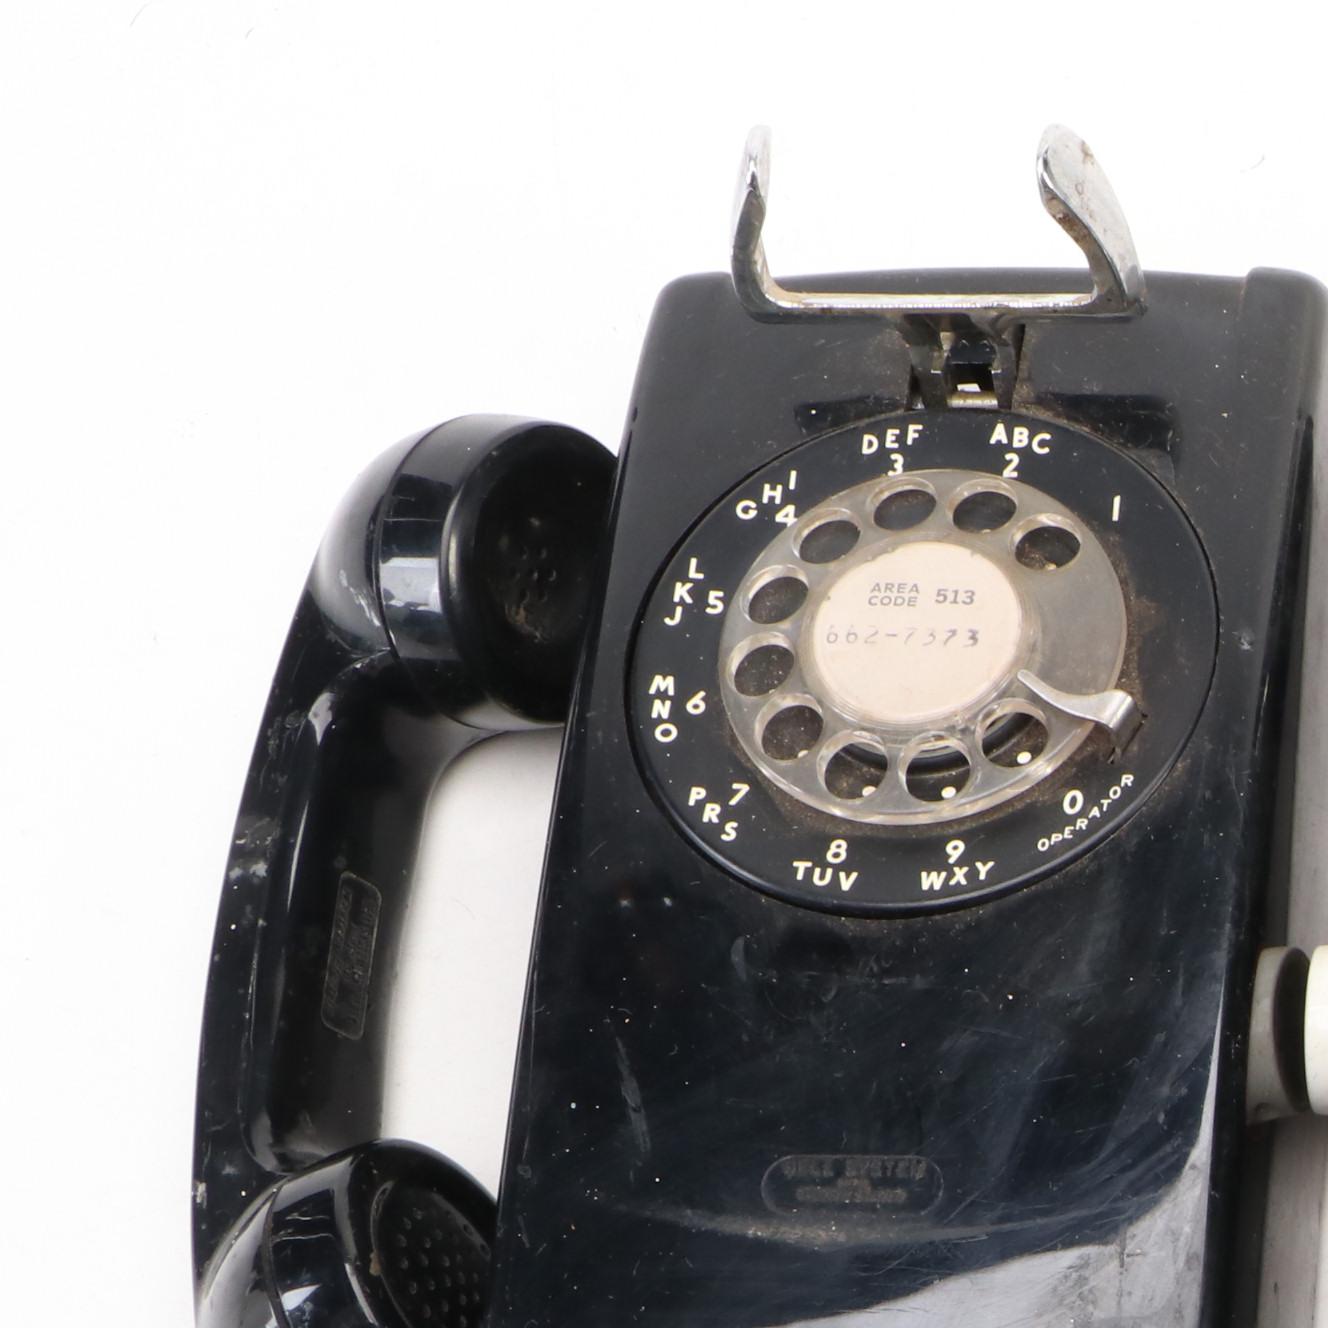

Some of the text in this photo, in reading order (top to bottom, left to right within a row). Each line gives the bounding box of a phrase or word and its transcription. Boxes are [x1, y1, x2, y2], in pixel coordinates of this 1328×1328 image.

[861, 424, 924, 456] DEF
[989, 424, 1052, 455] ABC
[887, 454, 905, 477] 3
[1002, 454, 1020, 478] 2
[735, 470, 797, 521] GHI
[775, 505, 797, 527] 4
[869, 582, 921, 594] AREA
[934, 588, 976, 606] 513
[705, 590, 725, 615] 5
[867, 595, 918, 608] CODE
[685, 690, 707, 716] 6
[728, 782, 750, 806] 7
[688, 786, 739, 842] PRS
[1037, 773, 1135, 852] OPERATOR
[826, 839, 848, 864] 8
[945, 839, 966, 864] 9
[792, 861, 859, 892] TUV
[920, 859, 995, 892] WXY
